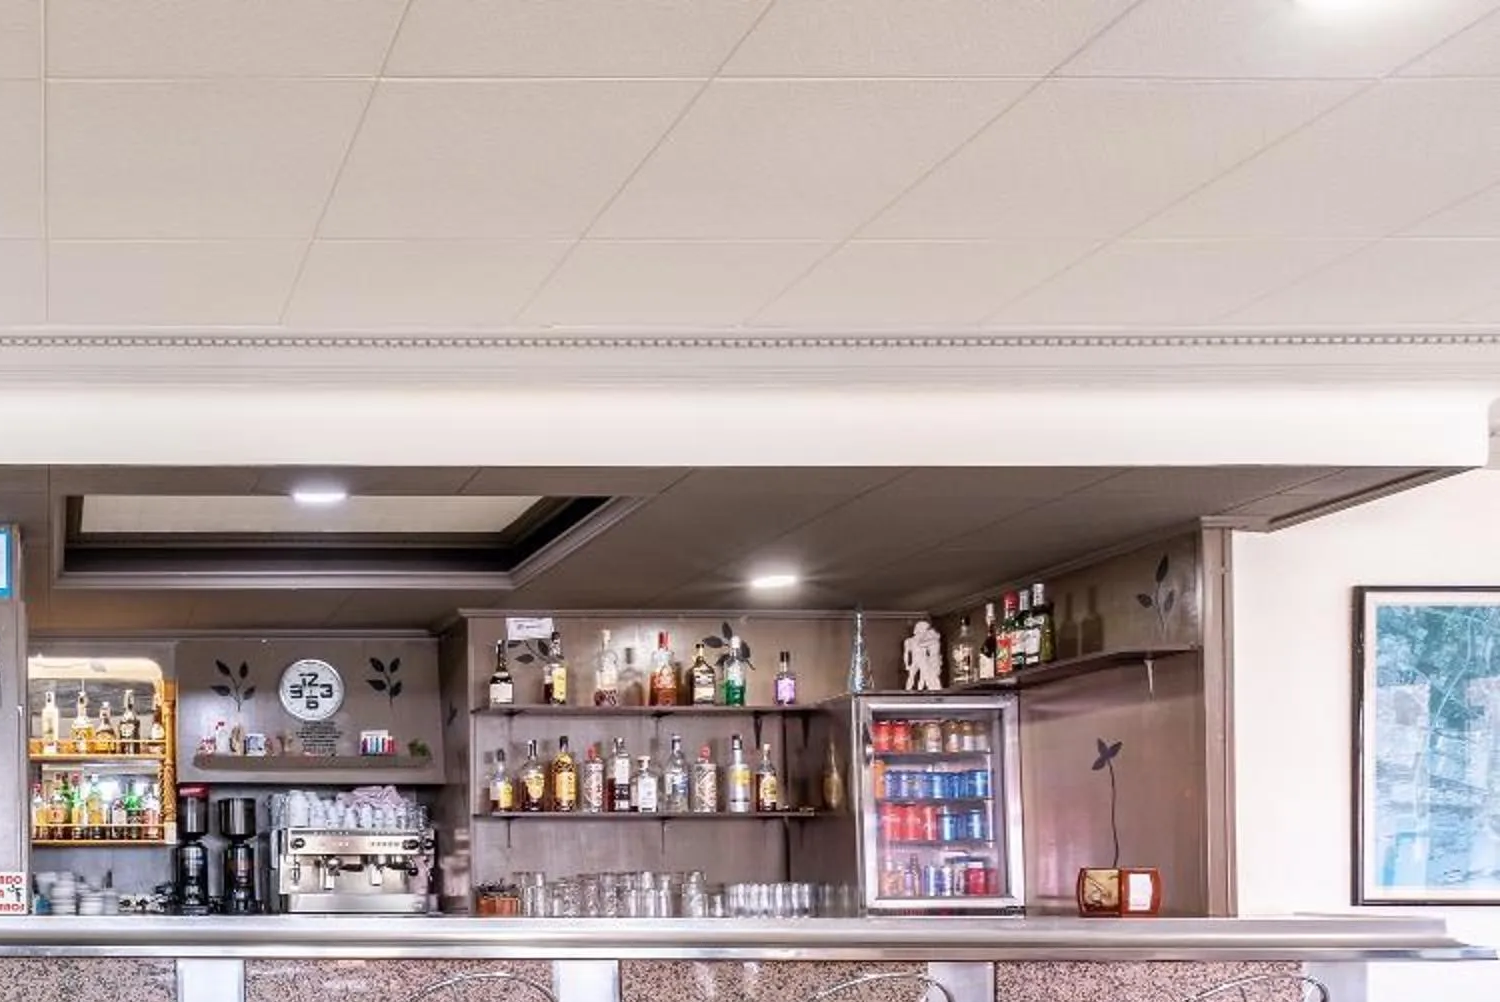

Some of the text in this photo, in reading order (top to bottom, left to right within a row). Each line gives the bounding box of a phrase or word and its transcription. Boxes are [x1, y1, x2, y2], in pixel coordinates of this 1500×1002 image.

[299, 673, 319, 687] 12
[290, 684, 303, 699] 9
[320, 684, 333, 699] 3
